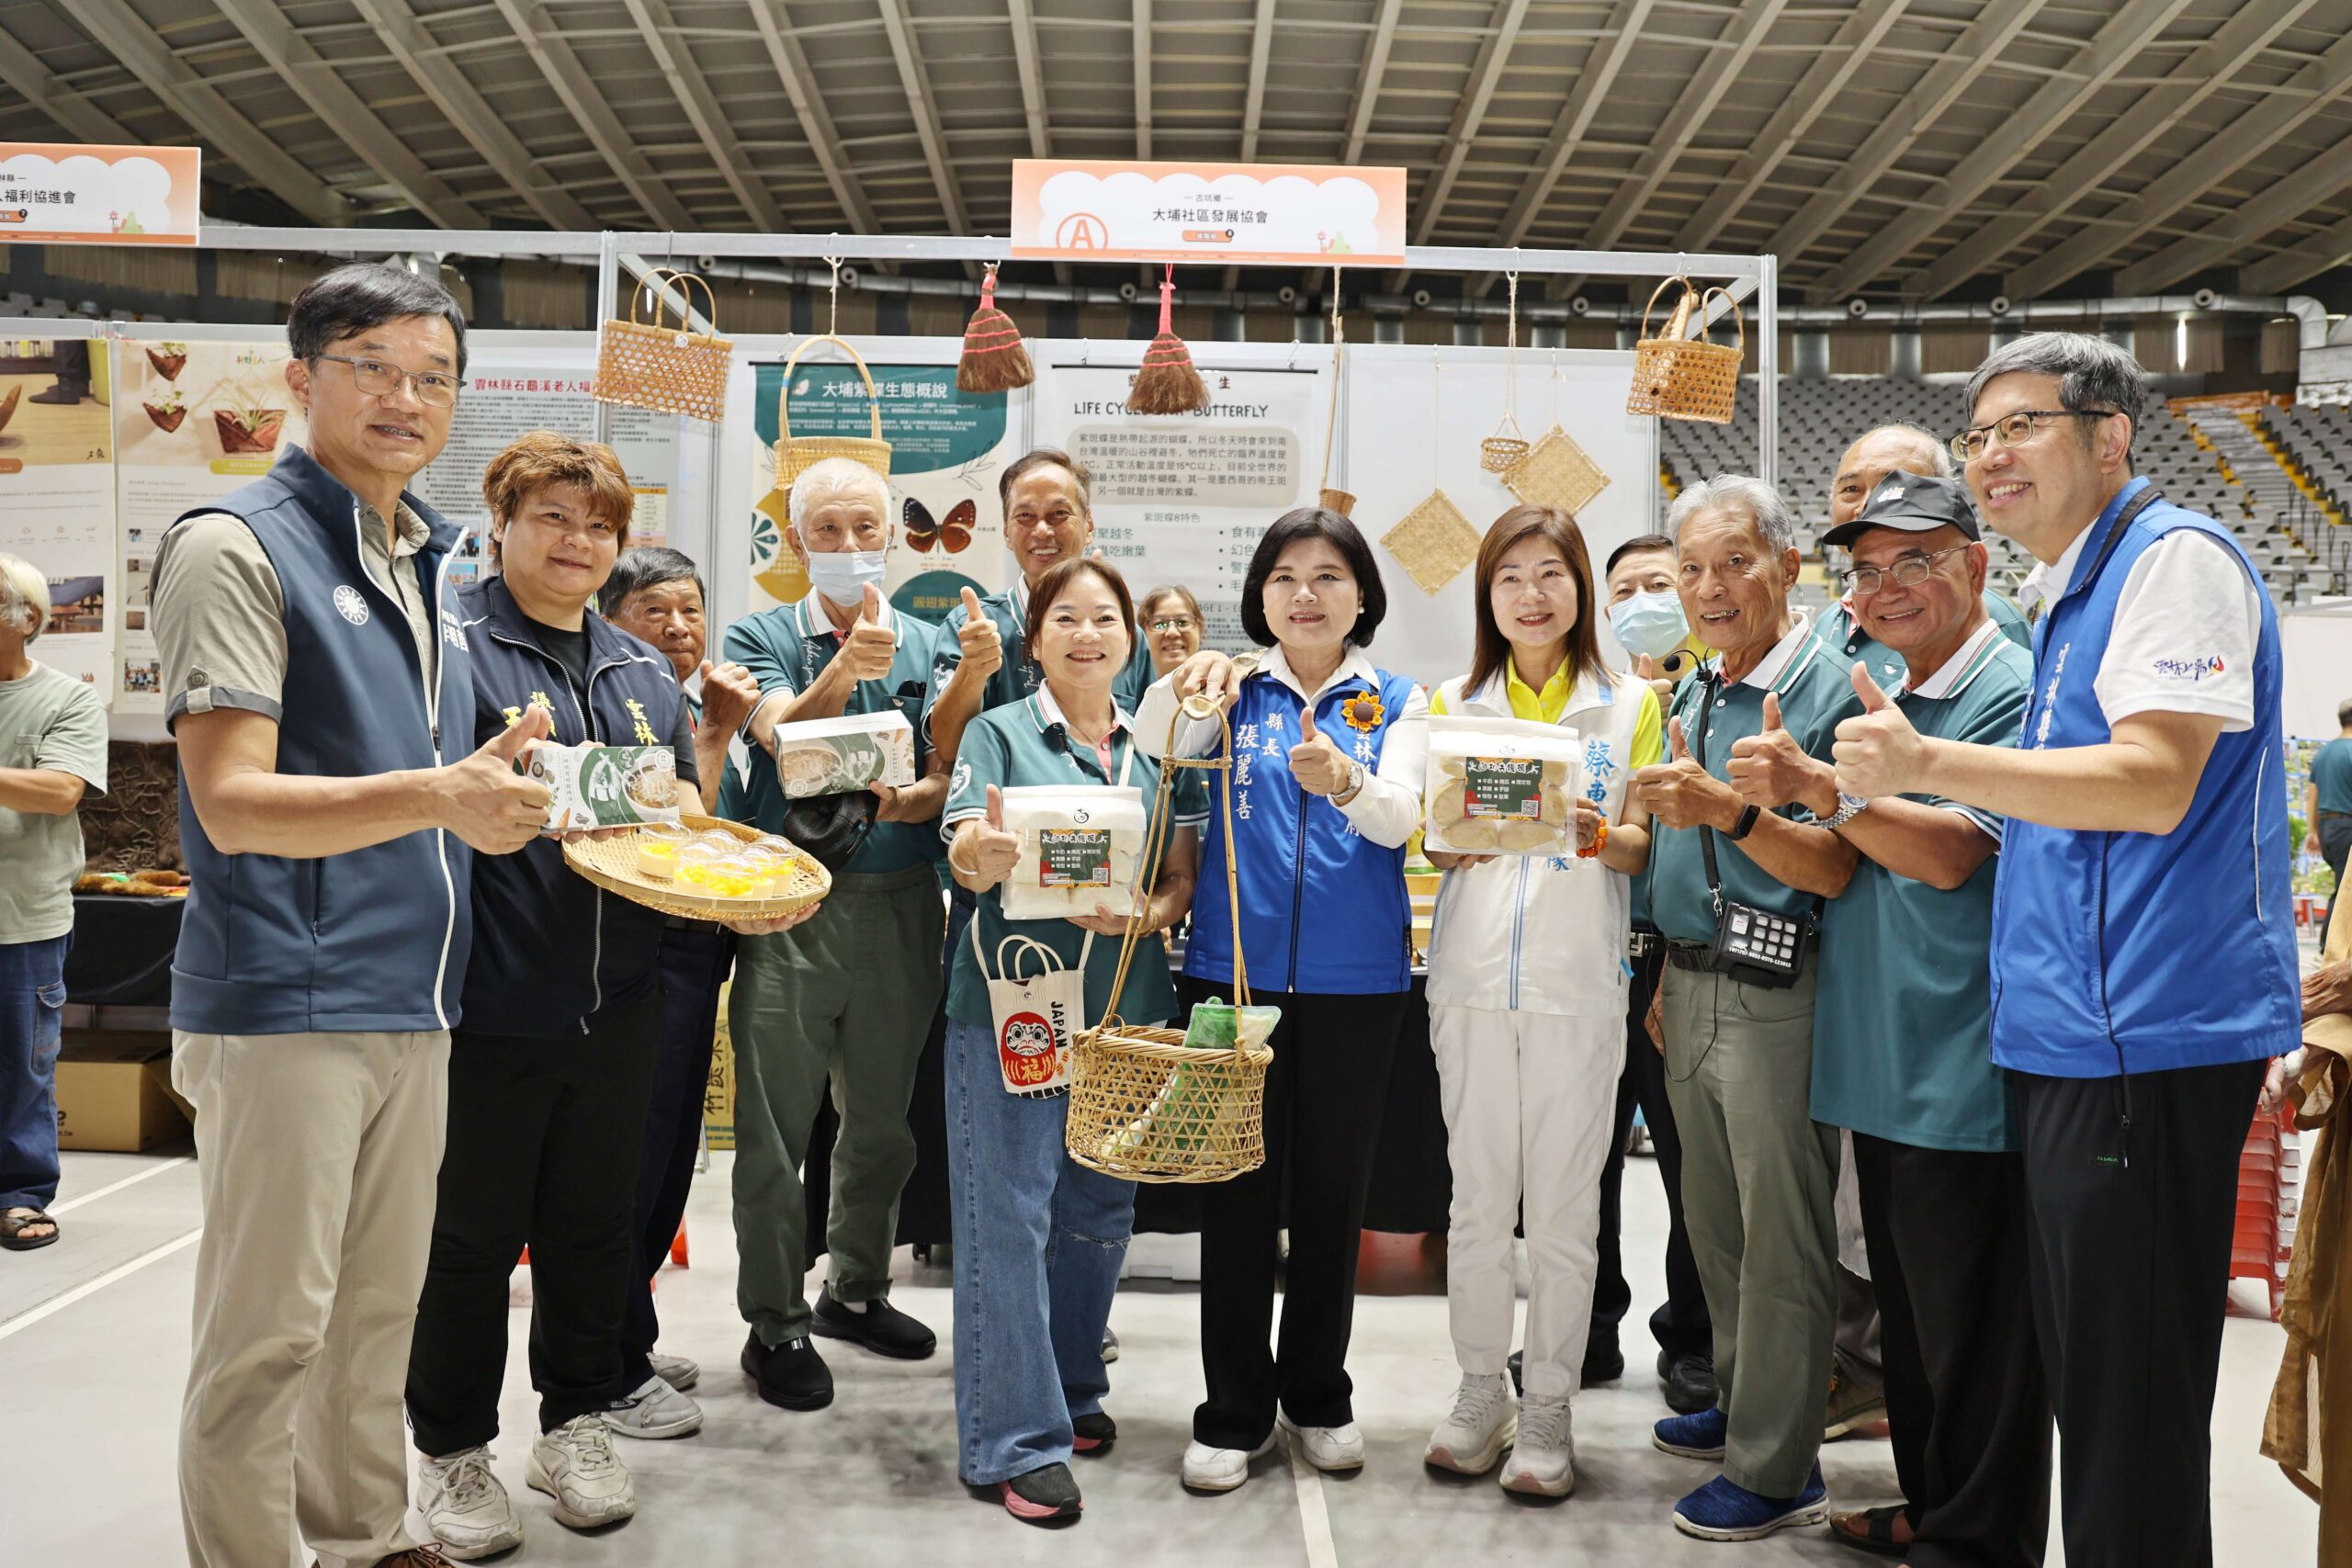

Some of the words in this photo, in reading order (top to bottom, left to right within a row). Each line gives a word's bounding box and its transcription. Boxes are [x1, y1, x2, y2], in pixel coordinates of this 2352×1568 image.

[0, 189, 76, 204] 福利協進會
[1195, 194, 1222, 202] 古坑鄉
[1152, 208, 1269, 223] 大埔社區發展協會
[1074, 401, 1101, 415] LIFE
[1193, 404, 1268, 418] BUTTERFLY
[1091, 527, 1134, 540] 聚越冬
[1261, 713, 1283, 757] 縣長
[1234, 723, 1261, 820] 張麗善
[1050, 1000, 1069, 1049] JAPAN
[1021, 1059, 1044, 1083] 福
